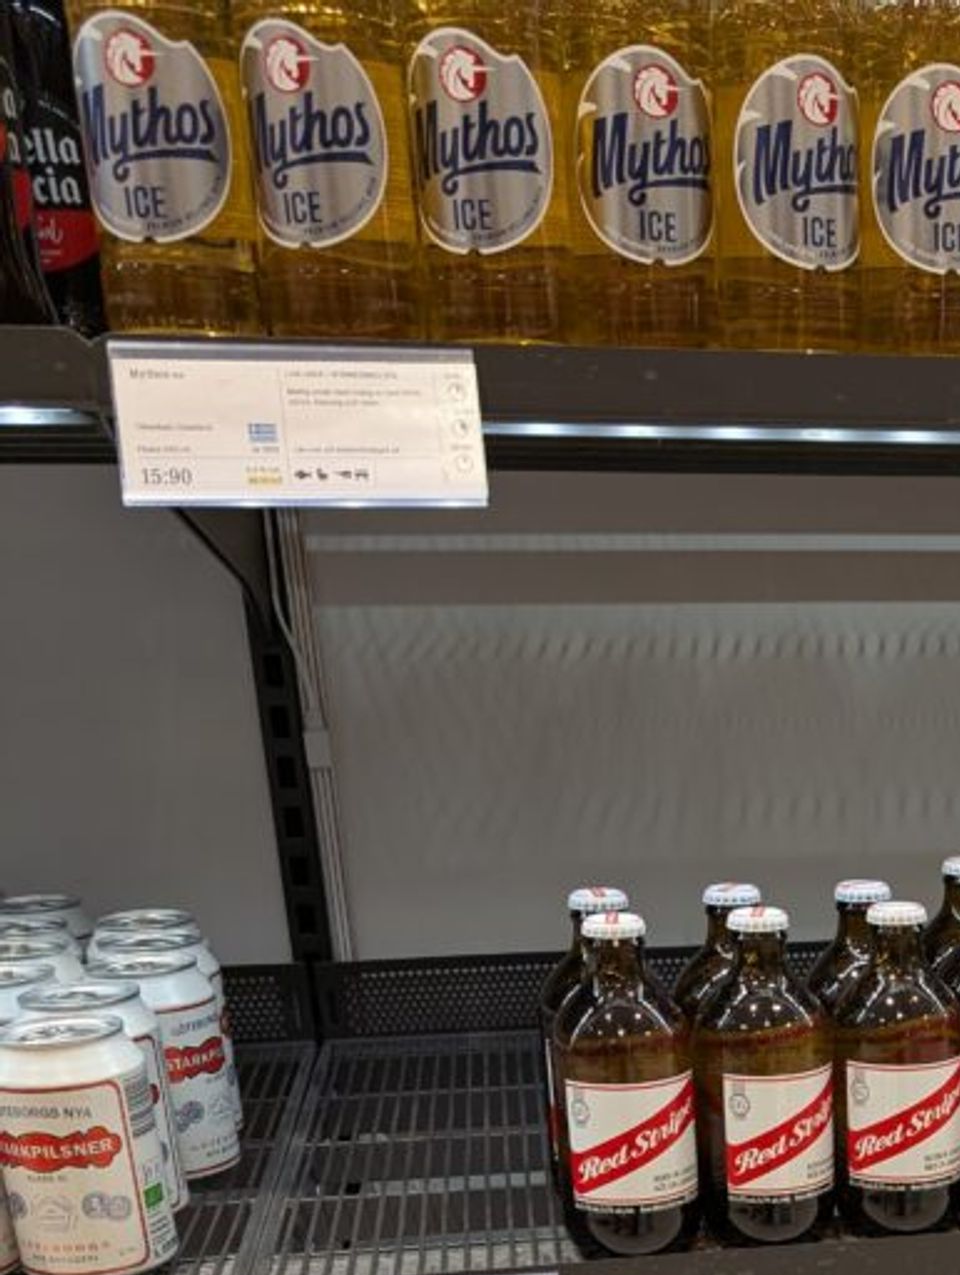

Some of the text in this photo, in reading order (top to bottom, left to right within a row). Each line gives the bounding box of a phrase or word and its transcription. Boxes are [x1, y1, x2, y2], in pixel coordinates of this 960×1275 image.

[124, 186, 167, 218] ICE
[283, 191, 323, 224] ICE
[453, 199, 493, 230] ICE
[639, 210, 678, 242] ICE
[802, 217, 838, 249] ICE
[141, 467, 193, 485] 15:90
[63, 1106, 92, 1119] NYA
[735, 1135, 788, 1175] Red
[855, 1121, 906, 1160] Red
[578, 1145, 628, 1183] Red
